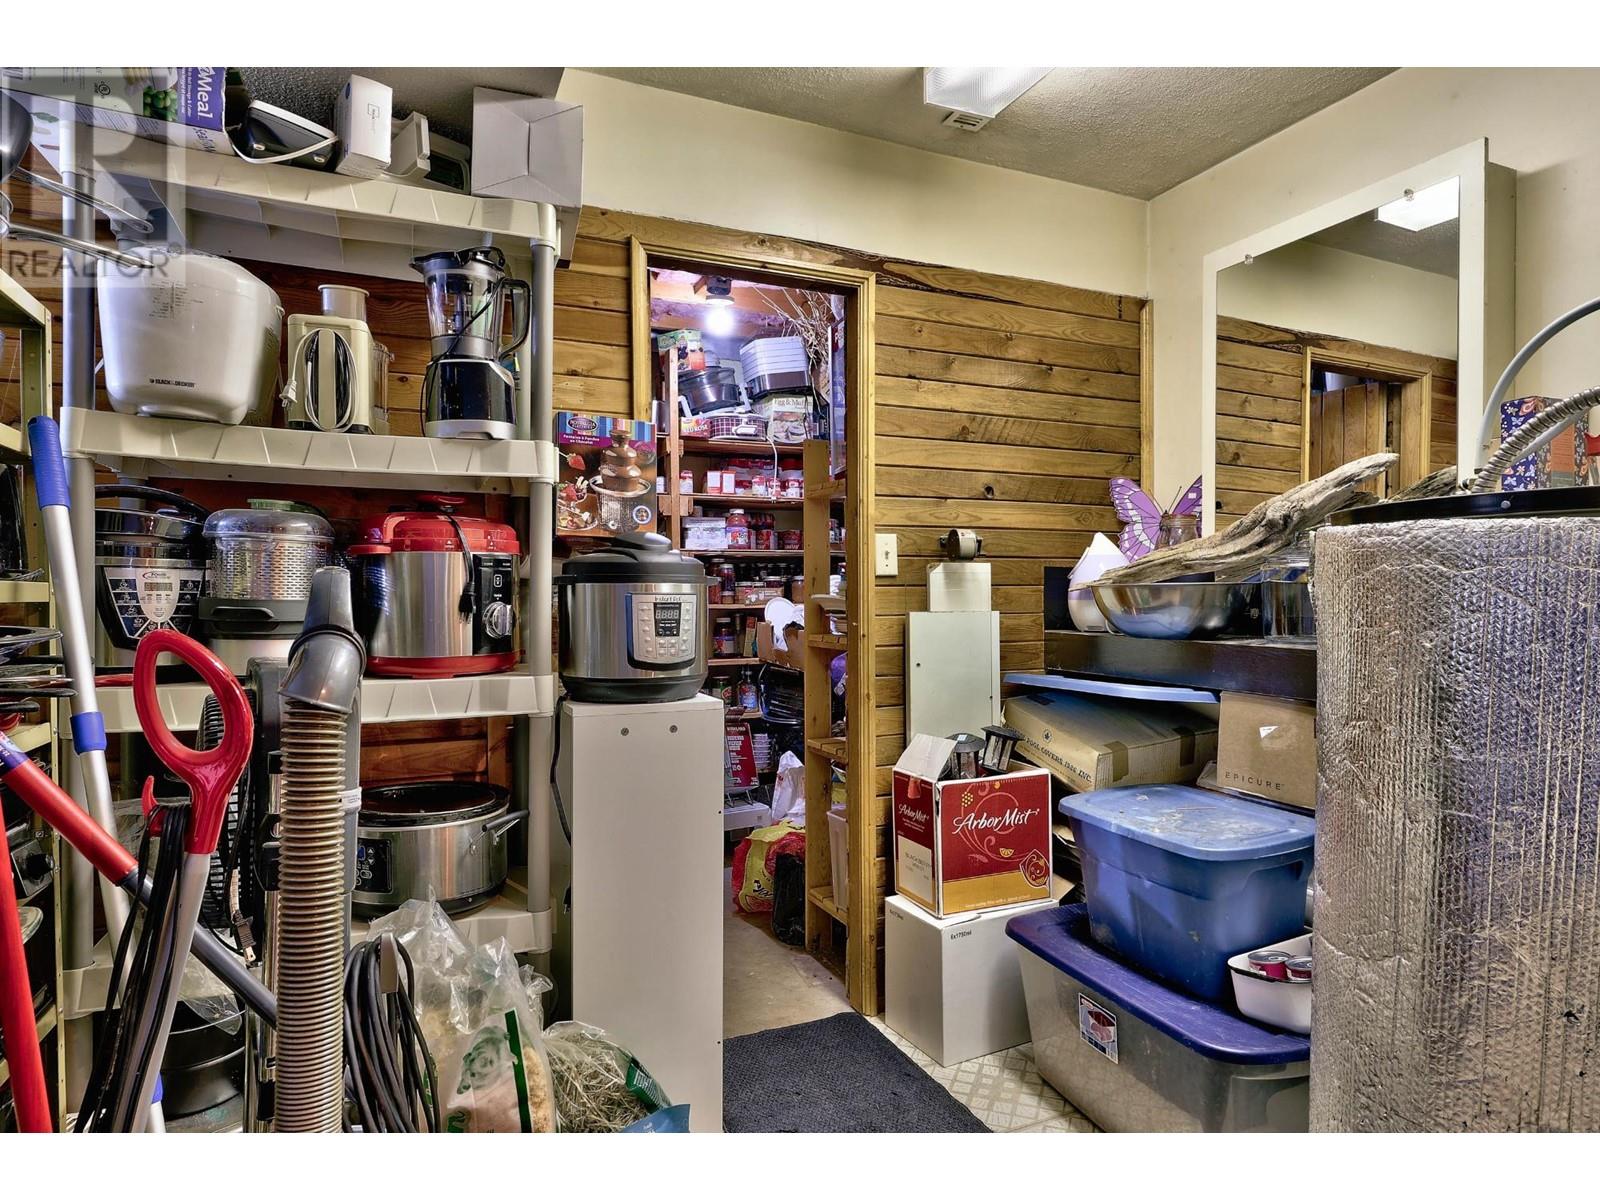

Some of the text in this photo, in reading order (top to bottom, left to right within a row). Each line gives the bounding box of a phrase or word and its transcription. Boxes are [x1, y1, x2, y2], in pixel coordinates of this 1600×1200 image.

[1225, 771, 1281, 791] EPICURE
[952, 812, 1001, 834] Arbor
[997, 807, 1038, 831] Mist
